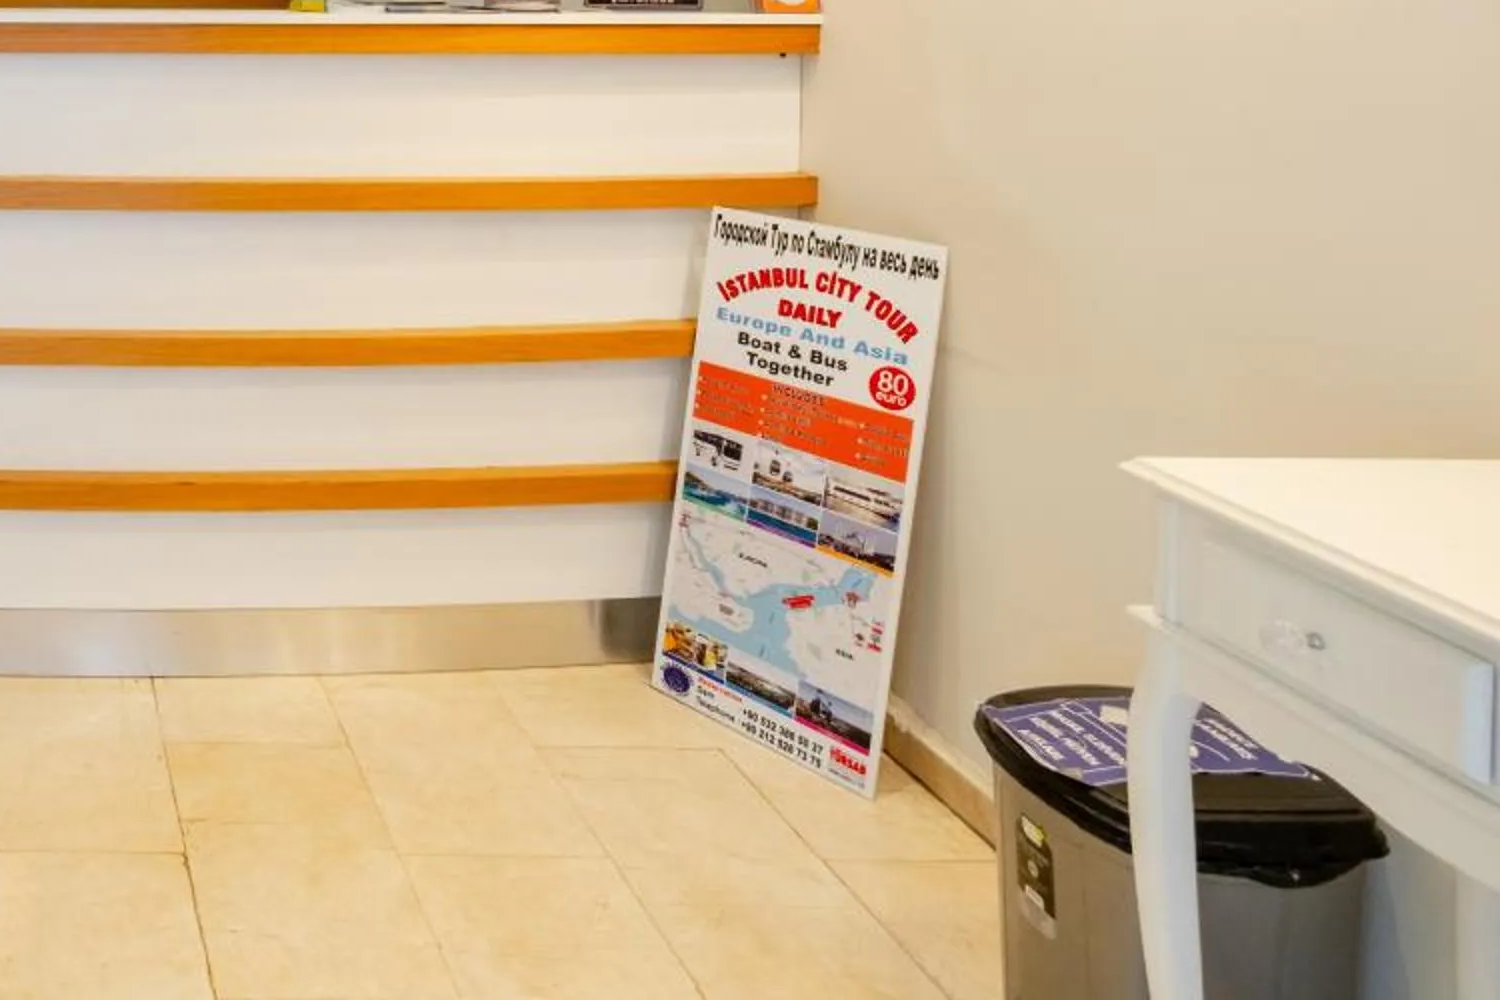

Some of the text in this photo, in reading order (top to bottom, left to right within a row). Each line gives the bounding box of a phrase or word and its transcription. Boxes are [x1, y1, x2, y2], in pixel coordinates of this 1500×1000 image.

[714, 213, 940, 281] Городской Тур по Стамбулу на весь день
[778, 298, 842, 328] DAILY
[865, 291, 918, 344] TOUR
[717, 307, 908, 366] Europe And Asia
[737, 331, 848, 372] Boat & Bus
[747, 351, 835, 387] Together
[877, 369, 909, 397] 80
[875, 391, 908, 408] euro
